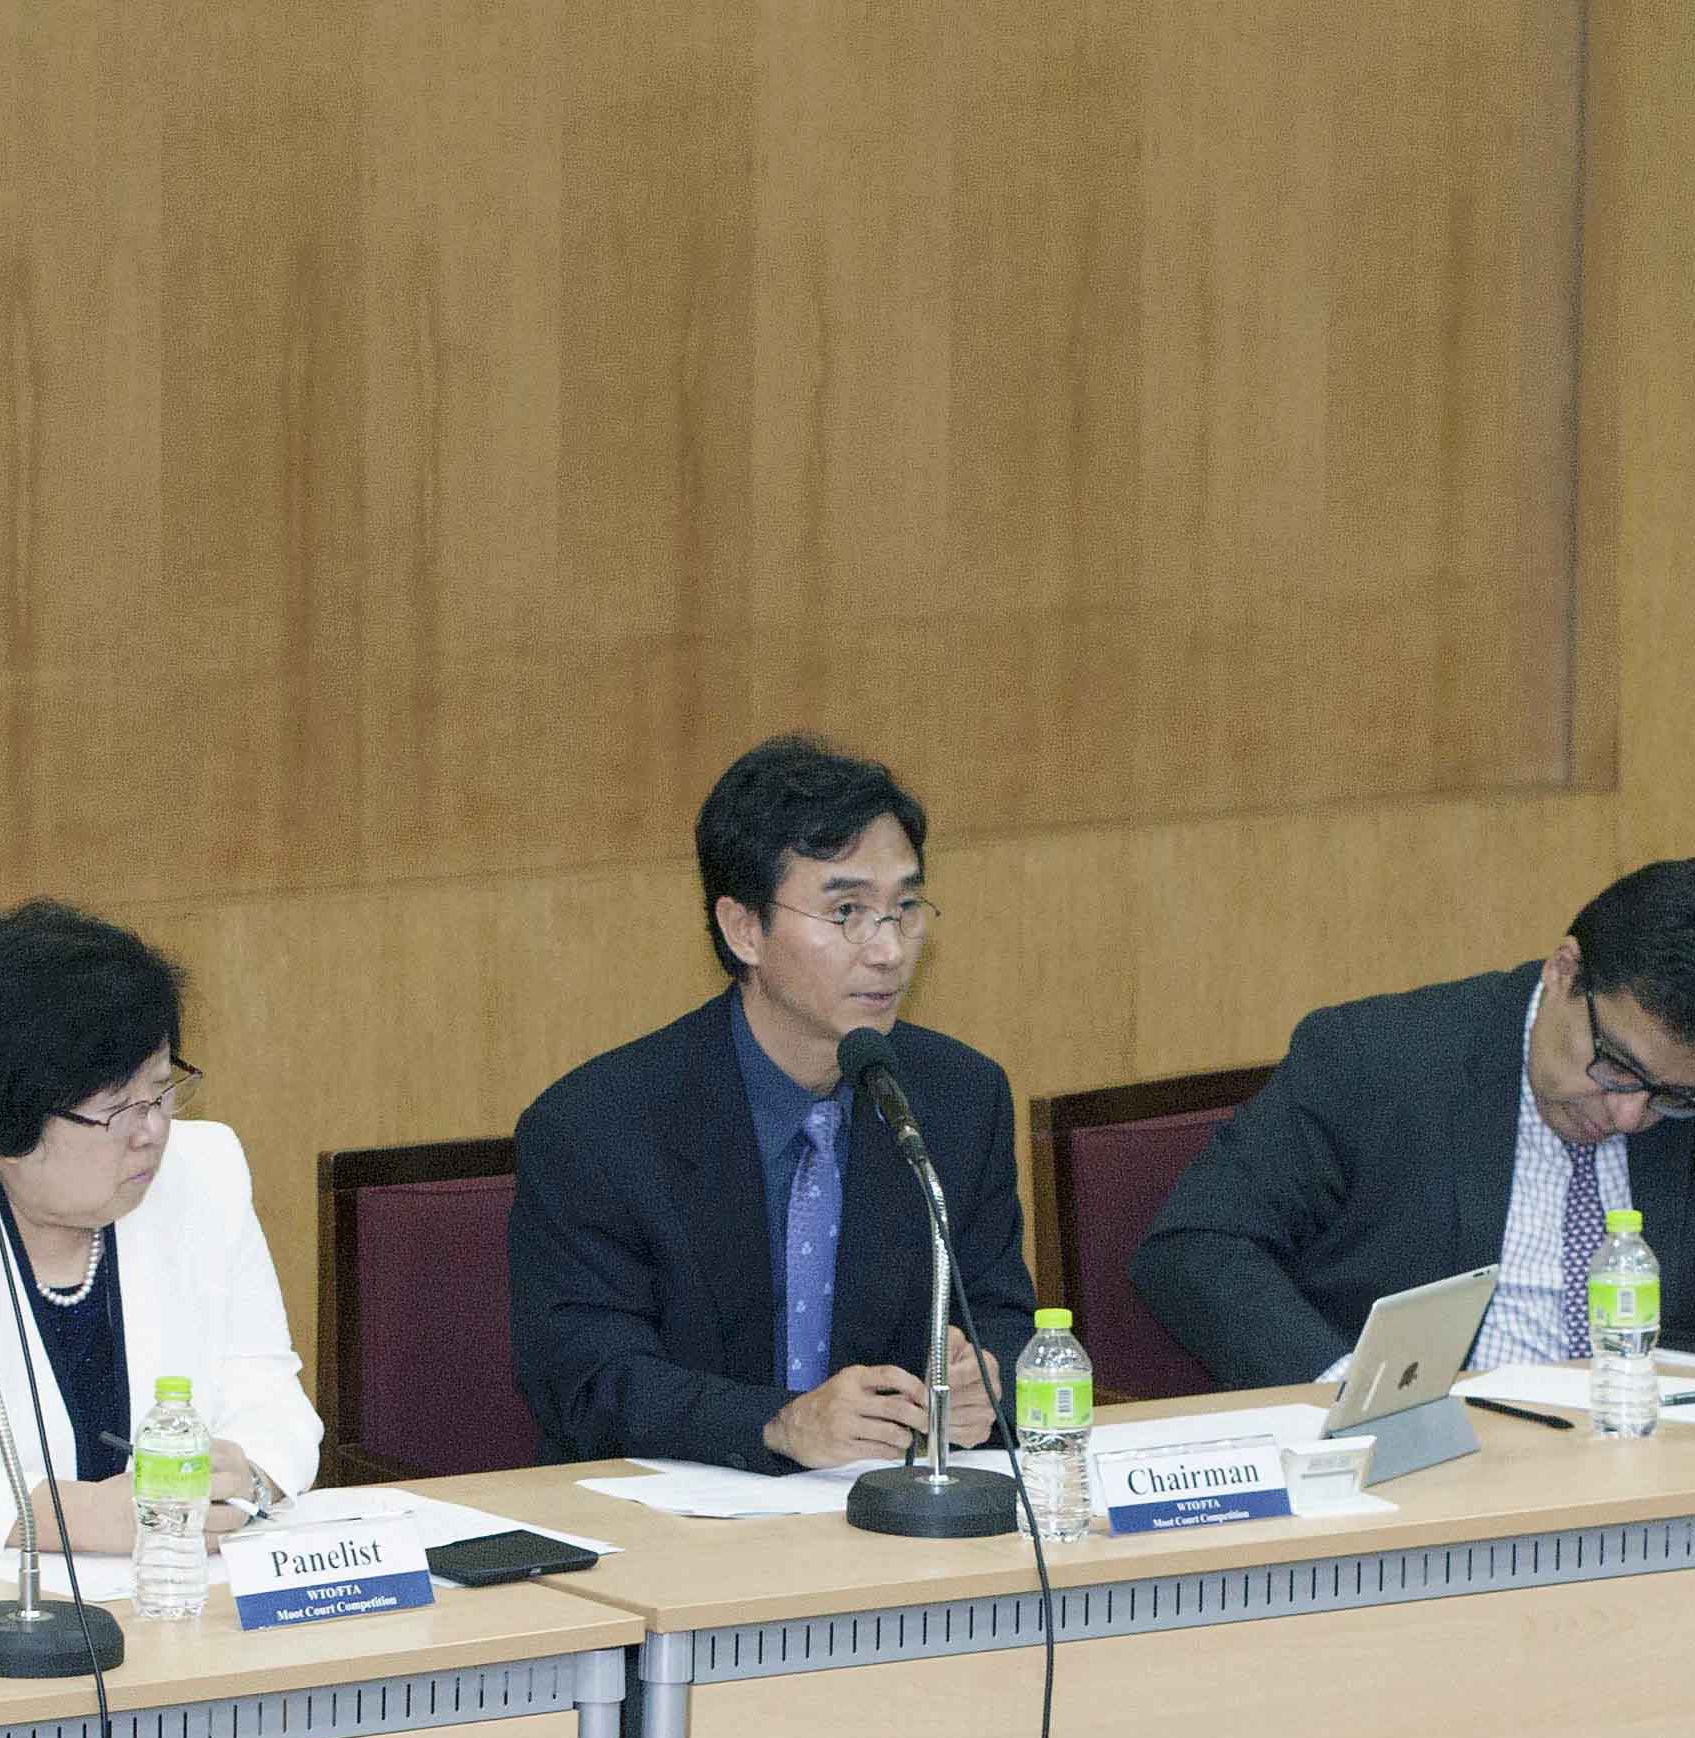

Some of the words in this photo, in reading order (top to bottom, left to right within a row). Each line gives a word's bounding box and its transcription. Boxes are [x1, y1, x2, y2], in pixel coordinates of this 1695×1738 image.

[1127, 1464, 1261, 1496] Chairman
[271, 1539, 383, 1577] Panelist
[306, 1584, 362, 1600] WTO/FTA
[305, 1604, 335, 1617] Court
[336, 1596, 397, 1612] Competition
